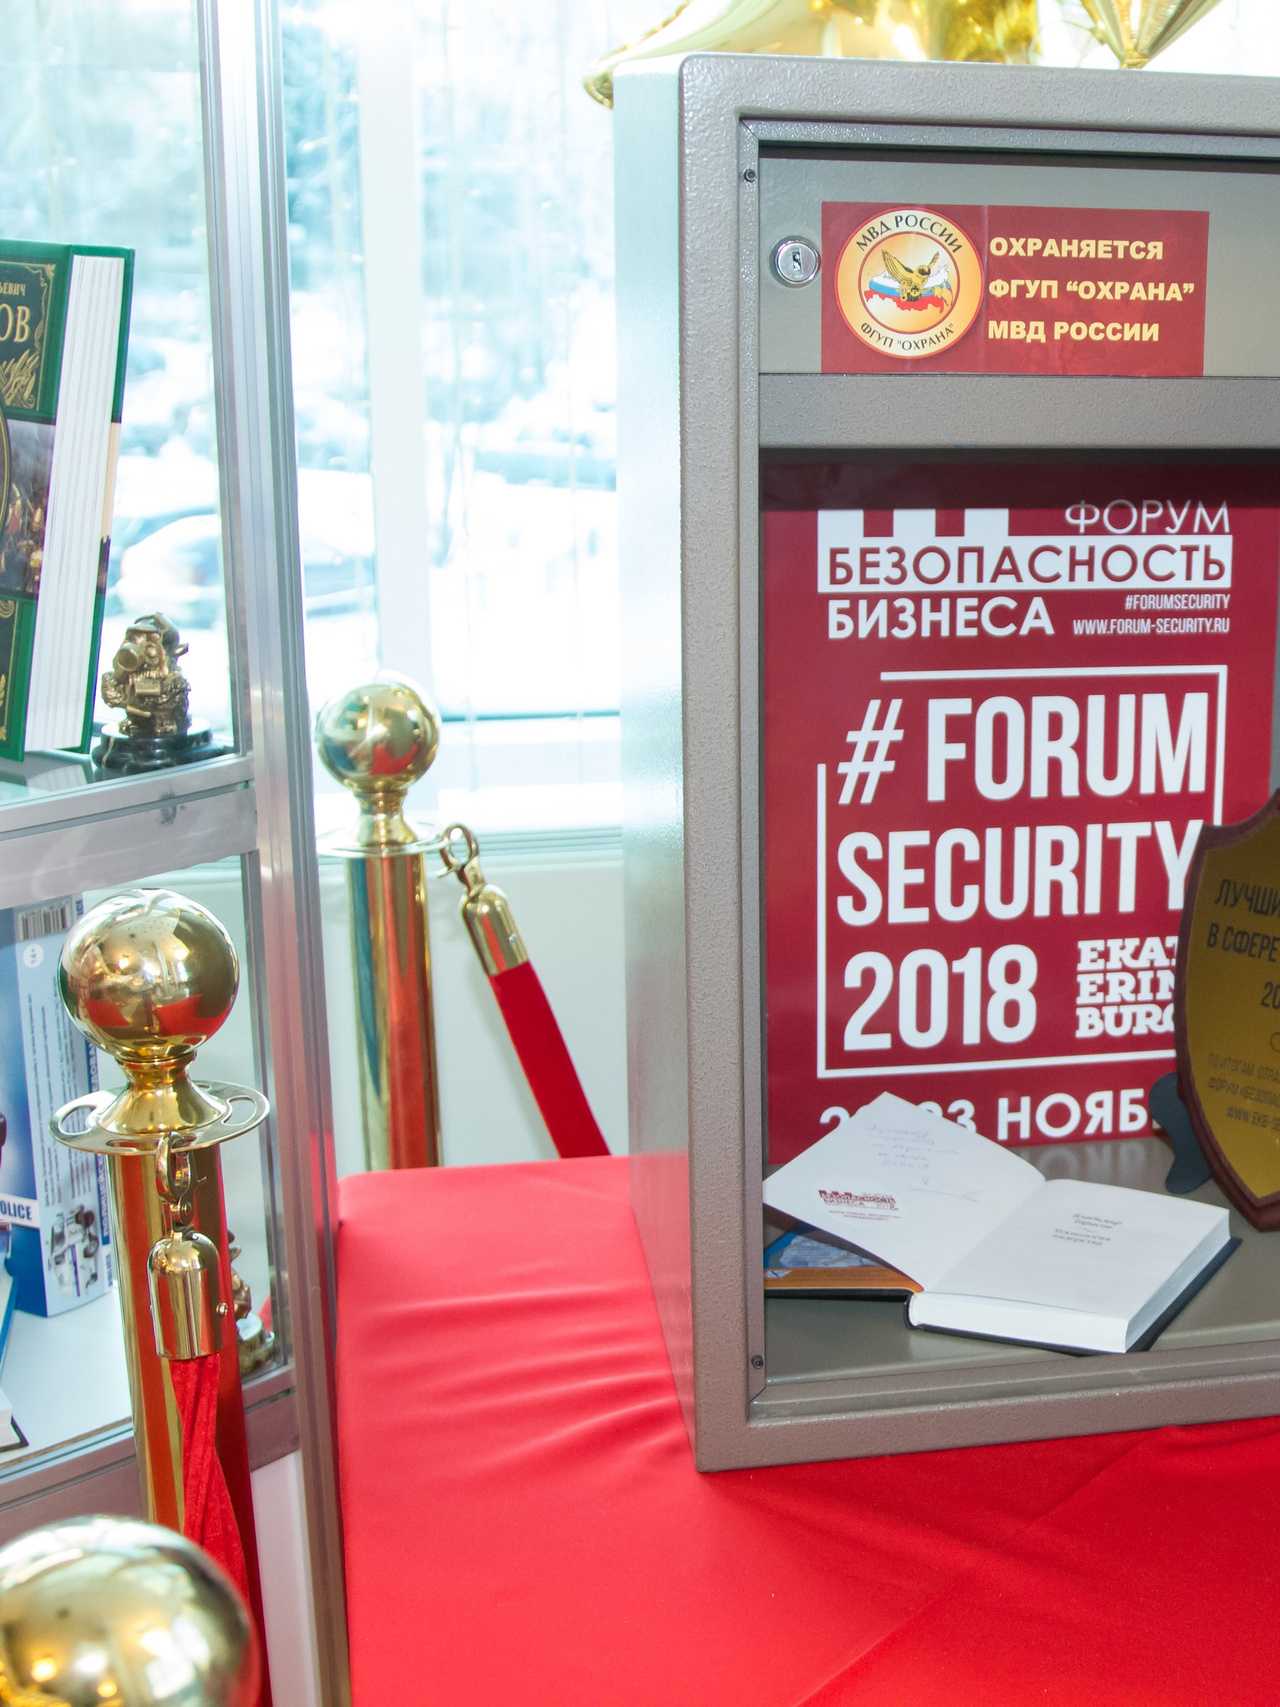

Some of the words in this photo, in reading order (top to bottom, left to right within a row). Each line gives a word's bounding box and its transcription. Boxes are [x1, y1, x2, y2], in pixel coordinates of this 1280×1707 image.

[855, 220, 892, 251] МВД
[895, 214, 963, 253] РОССИИ
[988, 236, 1164, 260] ОХРАНЯЕТСЯ
[988, 278, 1058, 300] ФГУП
[861, 322, 894, 348] ФГУП
[988, 320, 1046, 343] МВД
[1054, 321, 1160, 342] РОССИИ
[1064, 500, 1230, 535] ФОРУМ
[829, 544, 1226, 585] БЕЗОПАСНОСТЬ
[828, 596, 1055, 639] БИЗНЕСА
[1124, 594, 1230, 610] #FORUMSECURITY
[1073, 617, 1230, 636] WWW.FORUM-SECURITY.RU
[927, 692, 1209, 802] FORUM
[837, 819, 1203, 927] SECURITY
[1206, 922, 1220, 948] В
[1222, 926, 1280, 963] СФЕРЕ
[844, 944, 1038, 1052] 2018
[998, 1088, 1150, 1141] НОЯБ
